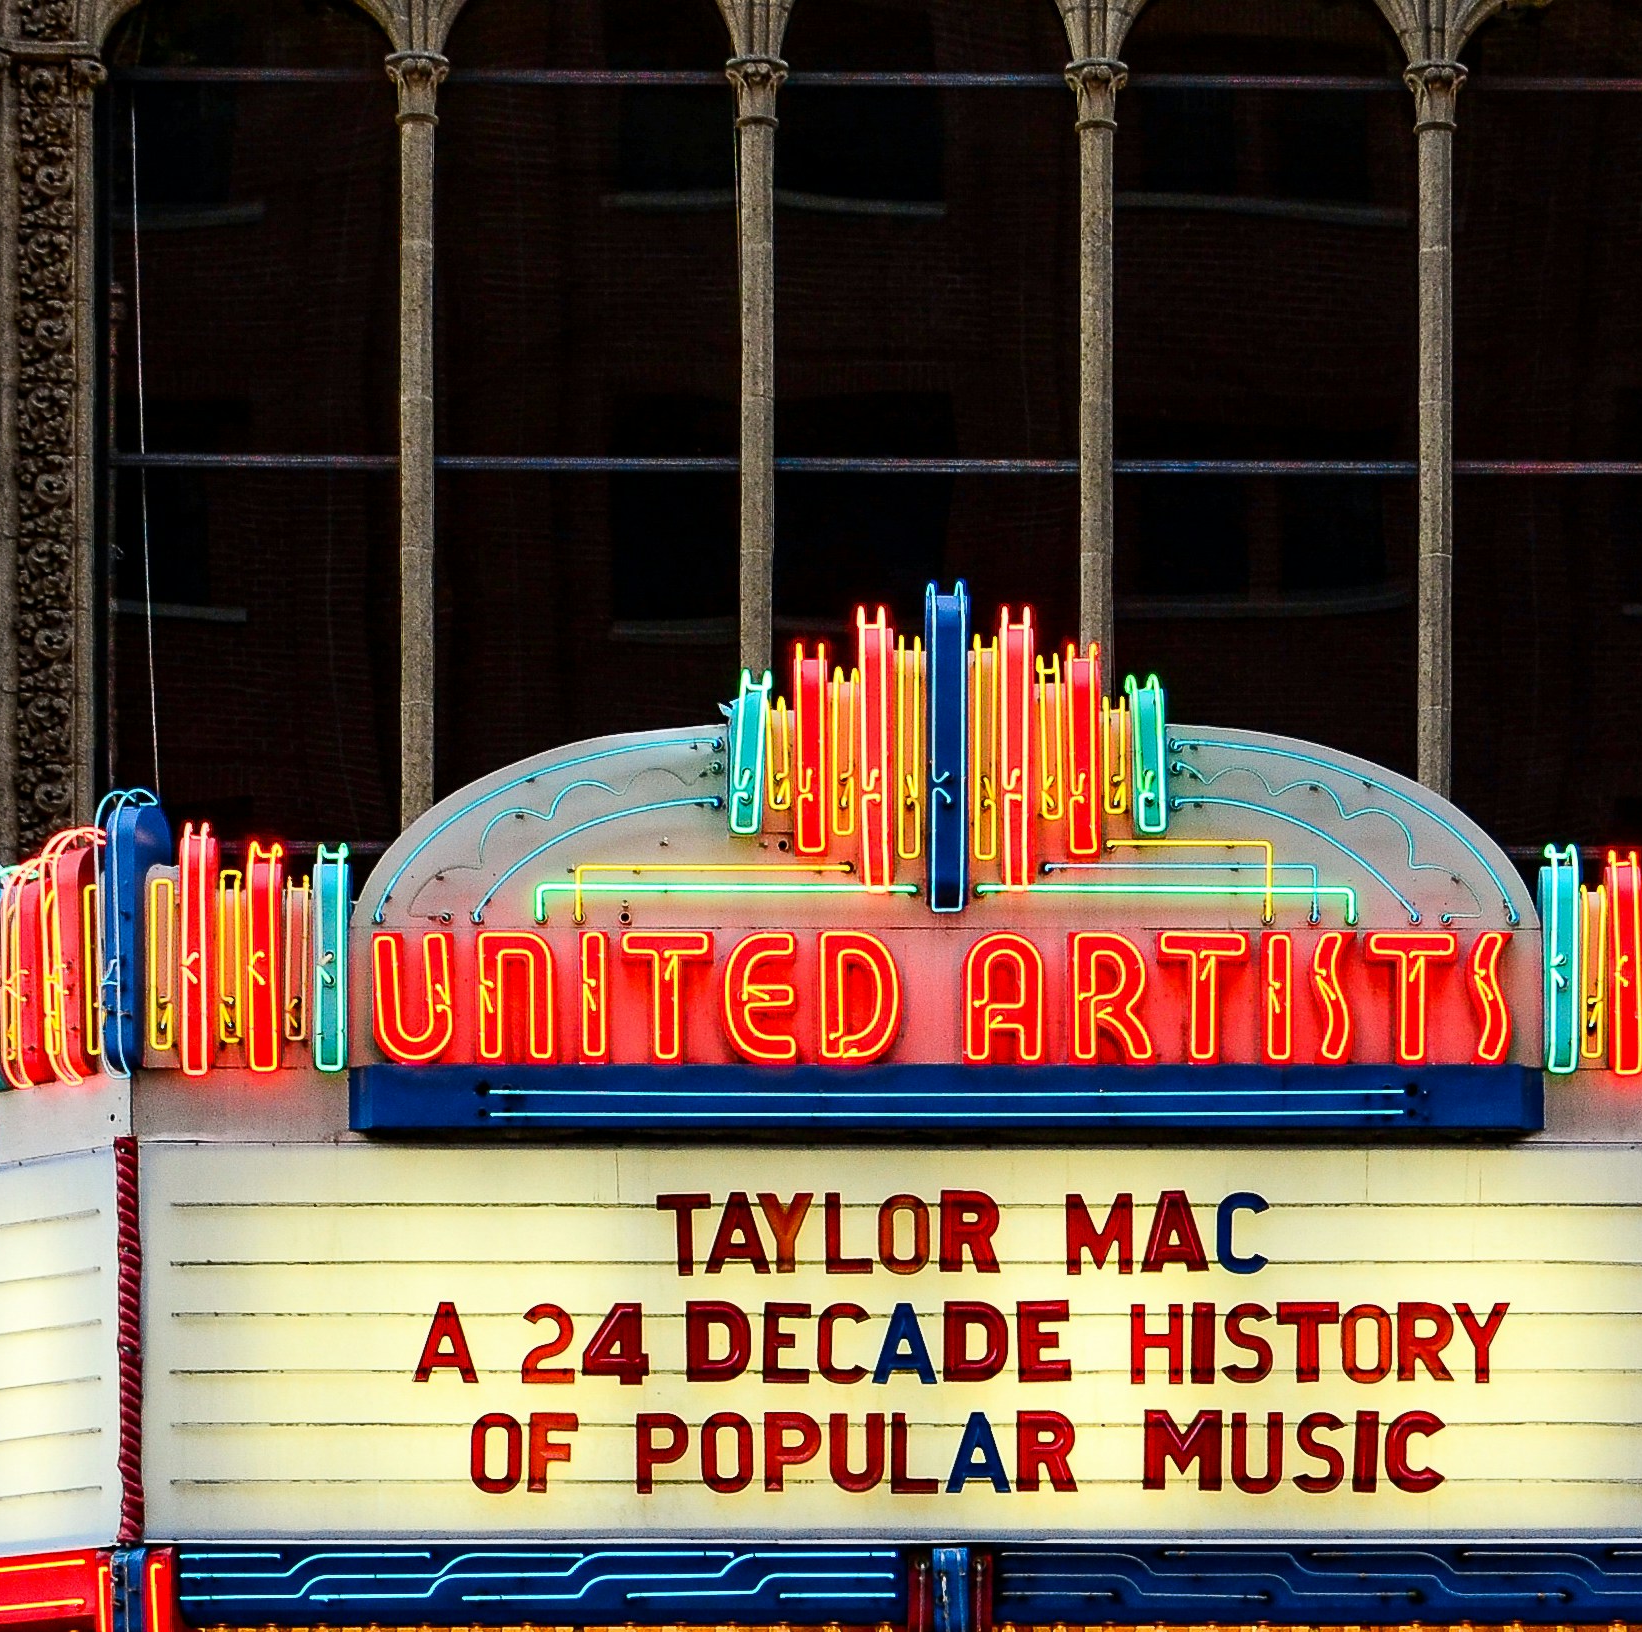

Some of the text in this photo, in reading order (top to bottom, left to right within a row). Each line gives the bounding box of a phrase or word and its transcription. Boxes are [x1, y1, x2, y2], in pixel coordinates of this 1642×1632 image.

[371, 930, 1515, 1064] UNITED ARTISTS
[656, 1189, 1270, 1277] TAYLOR MAC
[413, 1298, 1510, 1385] A 24 DECADE HISTORY
[469, 1408, 1447, 1495] OF POPULAR MUSIC
